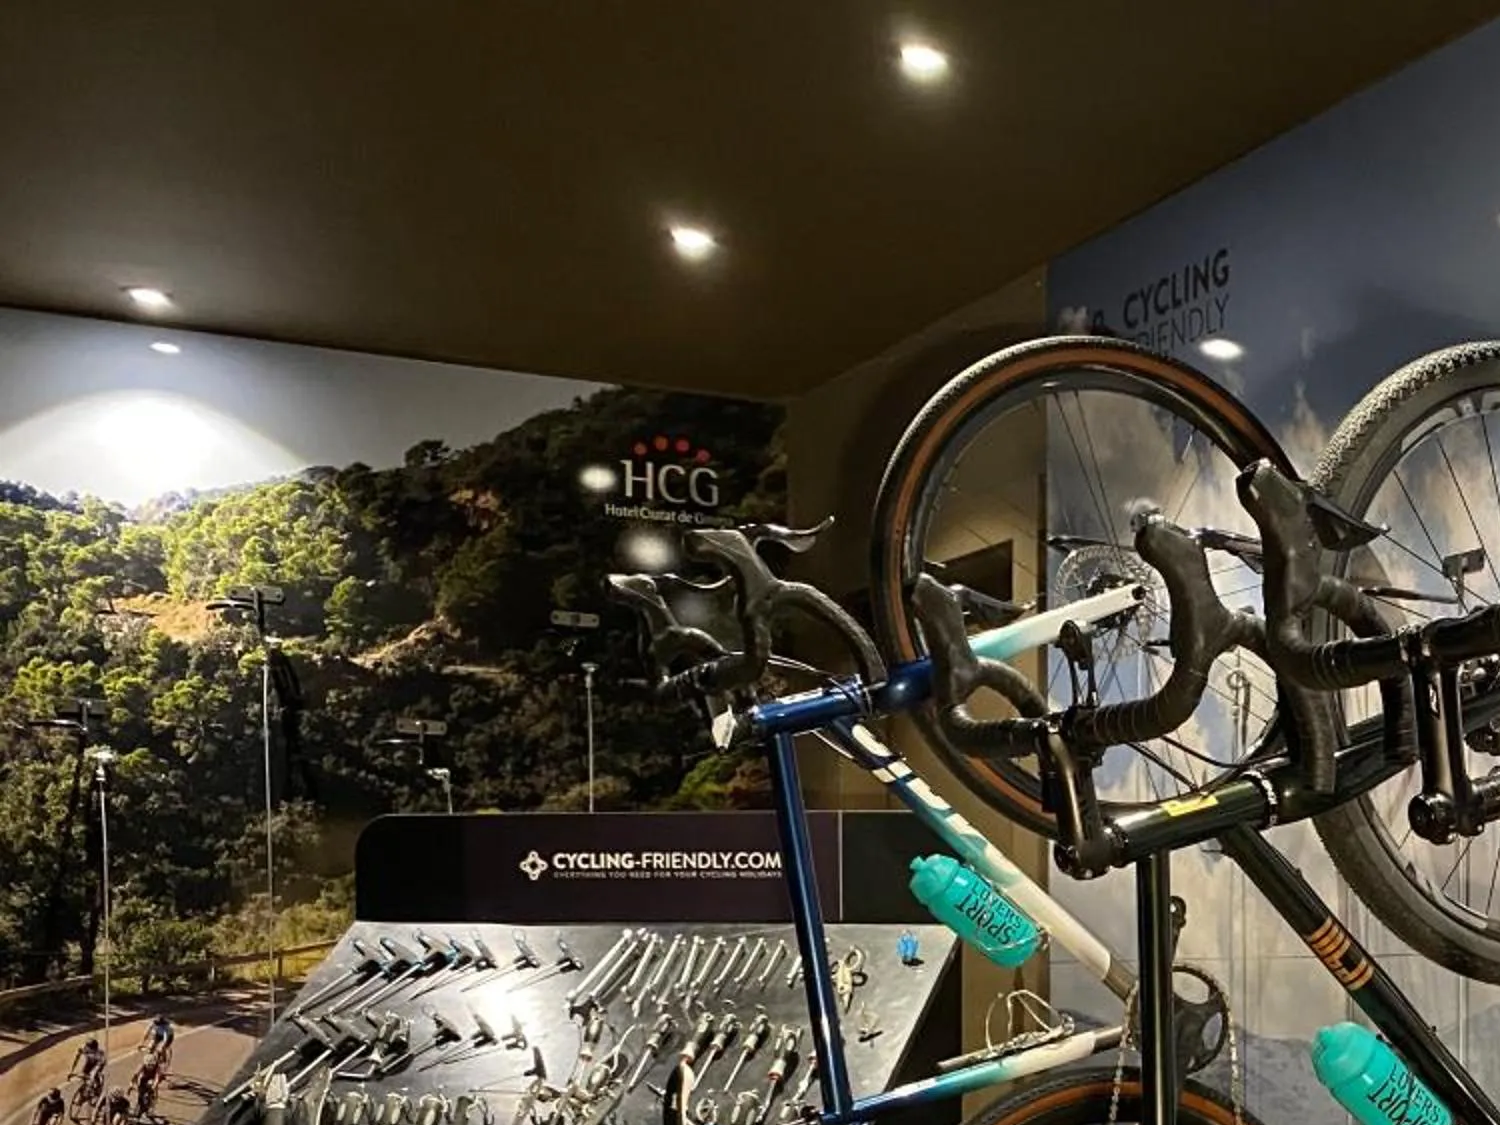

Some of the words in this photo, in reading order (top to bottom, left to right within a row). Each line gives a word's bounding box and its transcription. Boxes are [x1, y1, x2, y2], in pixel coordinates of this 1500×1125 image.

[1123, 248, 1230, 329] CYCLING
[620, 459, 719, 507] HCG
[553, 851, 782, 869] CYCLING-FRIENDLY.COM
[954, 893, 1015, 945] SPORT
